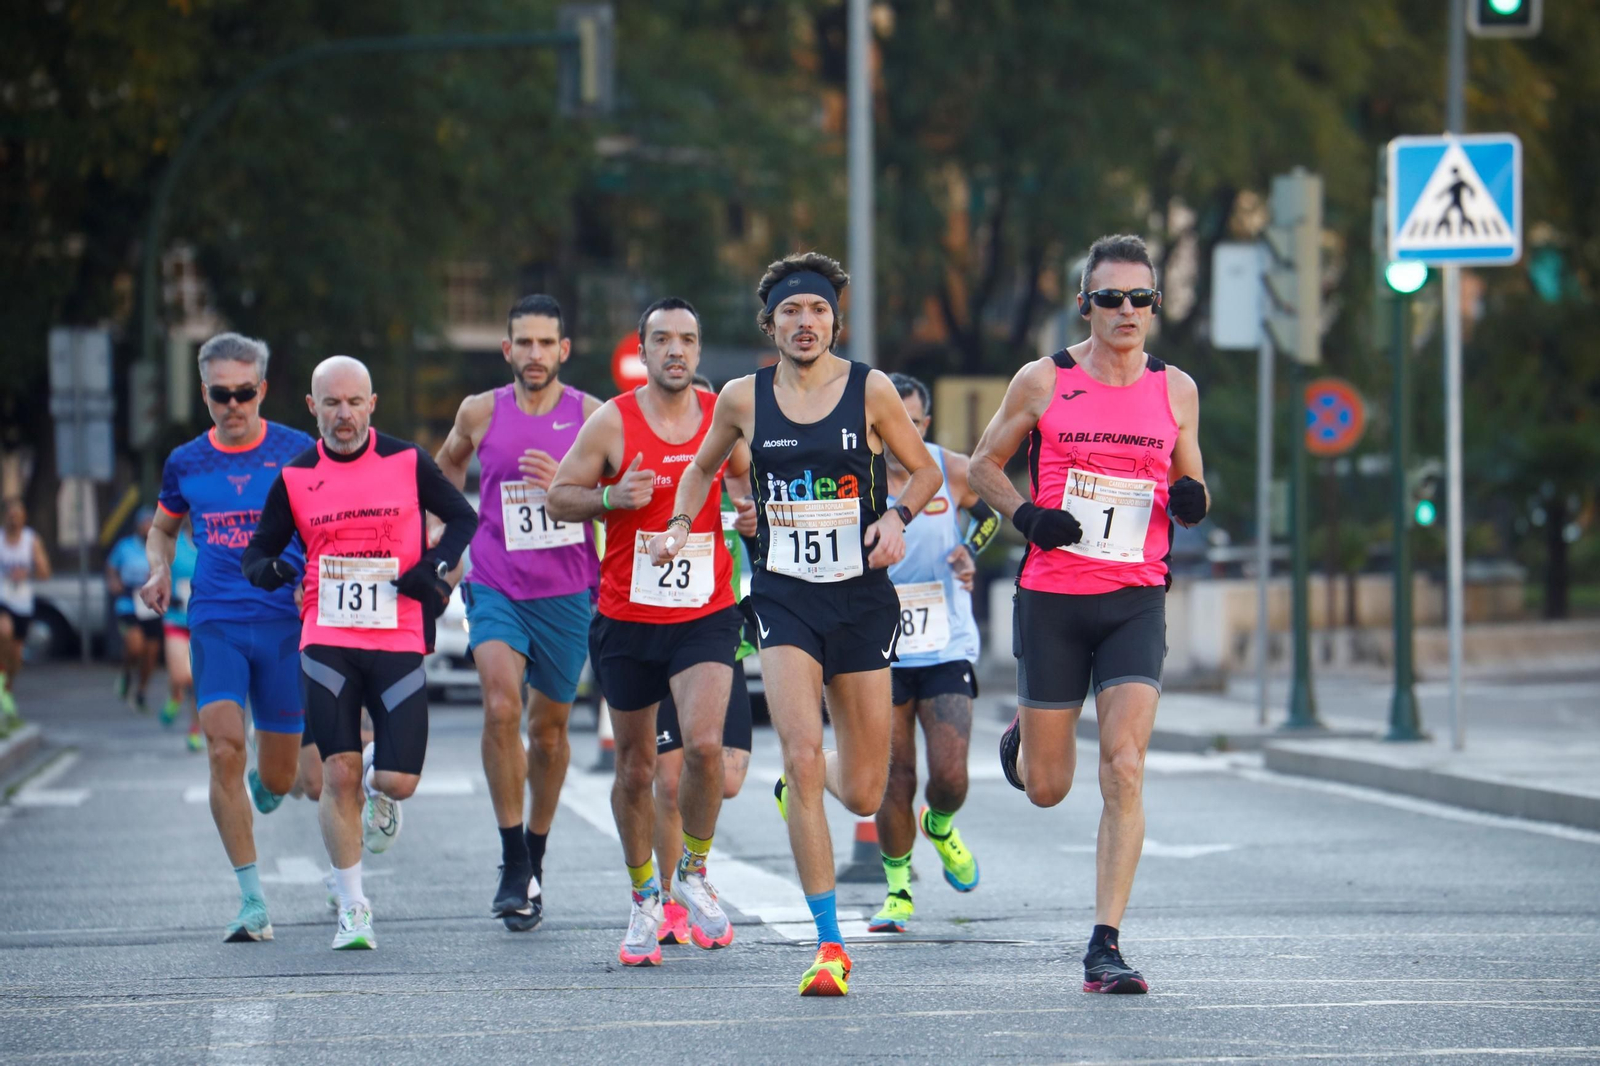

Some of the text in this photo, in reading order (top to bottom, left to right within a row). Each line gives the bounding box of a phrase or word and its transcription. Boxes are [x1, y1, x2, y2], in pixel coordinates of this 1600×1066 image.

[1058, 432, 1164, 449] TABLERUNNERS
[766, 470, 859, 501] indea
[1070, 473, 1098, 500] XLI
[309, 507, 400, 527] TABLERUNNERS
[518, 505, 566, 533] 31
[770, 504, 796, 528] XLI
[1102, 507, 1115, 539] 1
[789, 529, 839, 564] 151
[658, 559, 691, 589] 23
[336, 582, 378, 612] 131
[901, 607, 929, 637] 87
